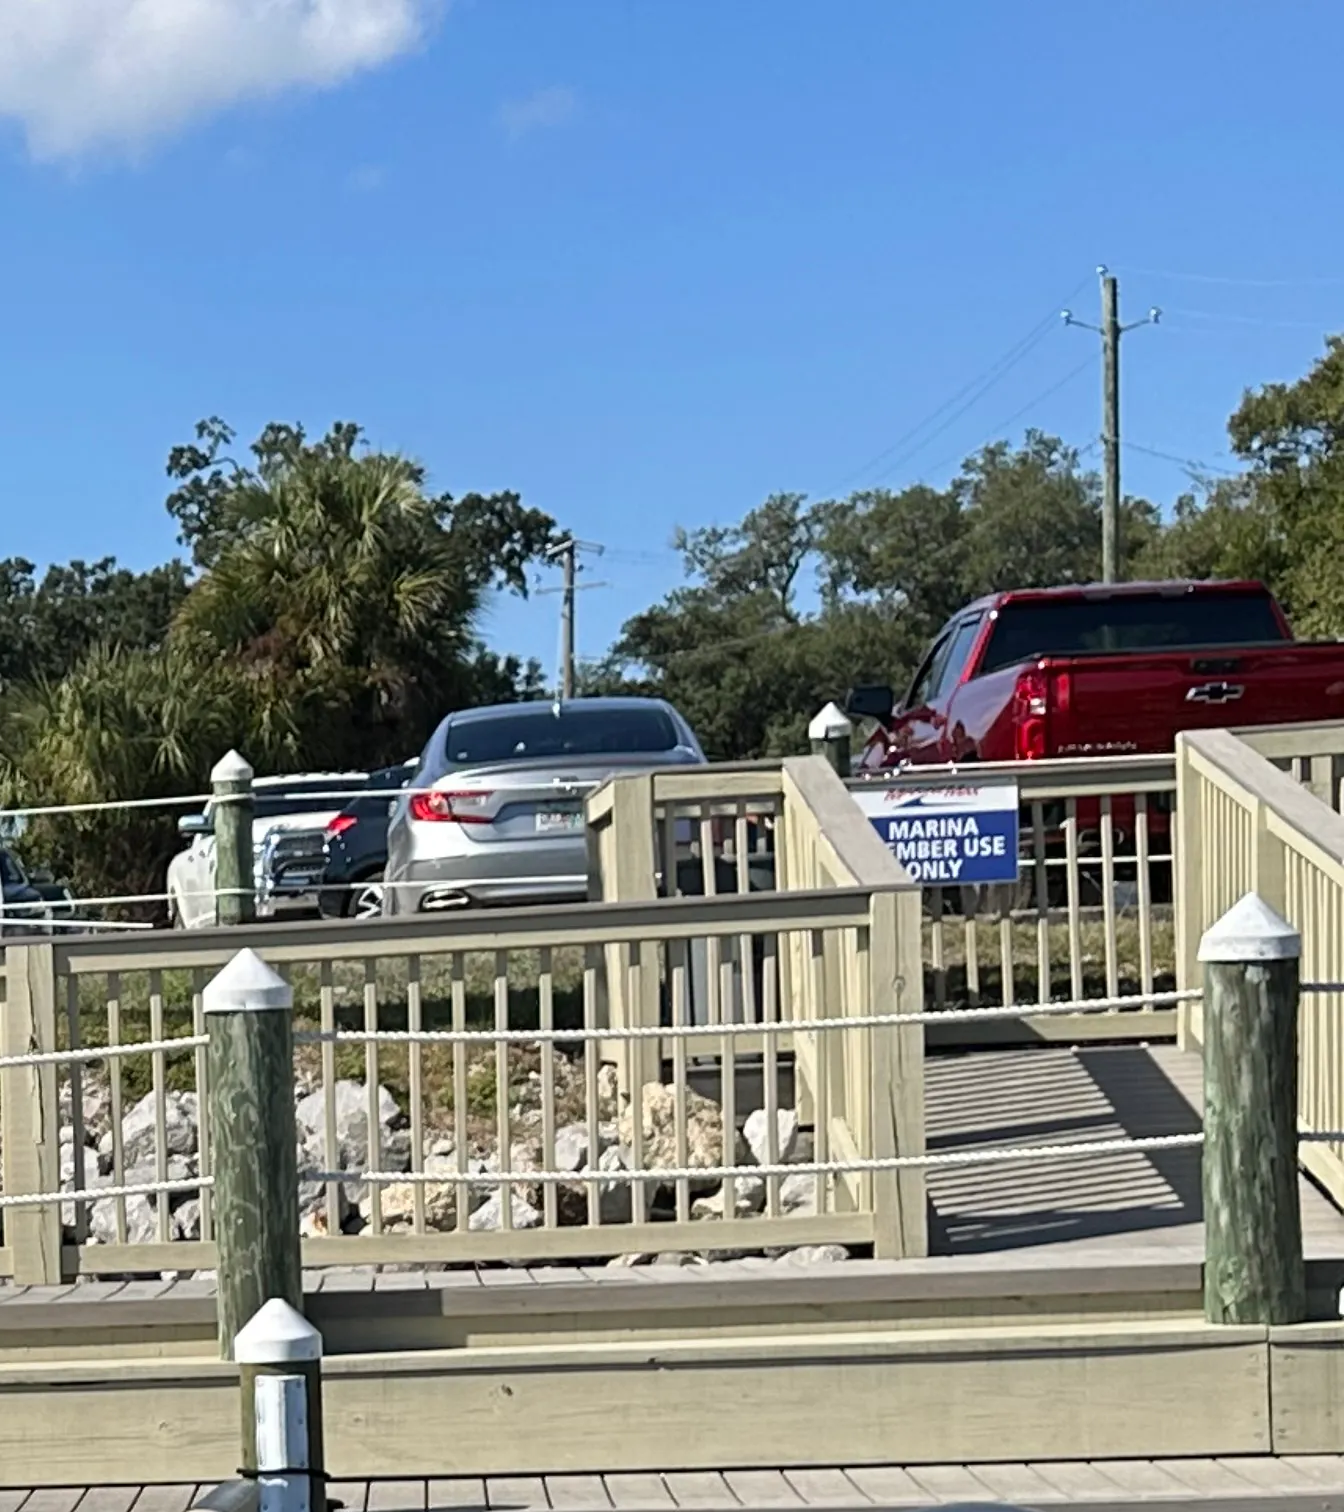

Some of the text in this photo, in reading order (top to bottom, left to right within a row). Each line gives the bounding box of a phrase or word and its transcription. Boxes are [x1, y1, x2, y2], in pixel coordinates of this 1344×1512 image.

[889, 816, 979, 840] MARINA
[888, 835, 1006, 860] MBER USE
[905, 859, 964, 880] ONLY
